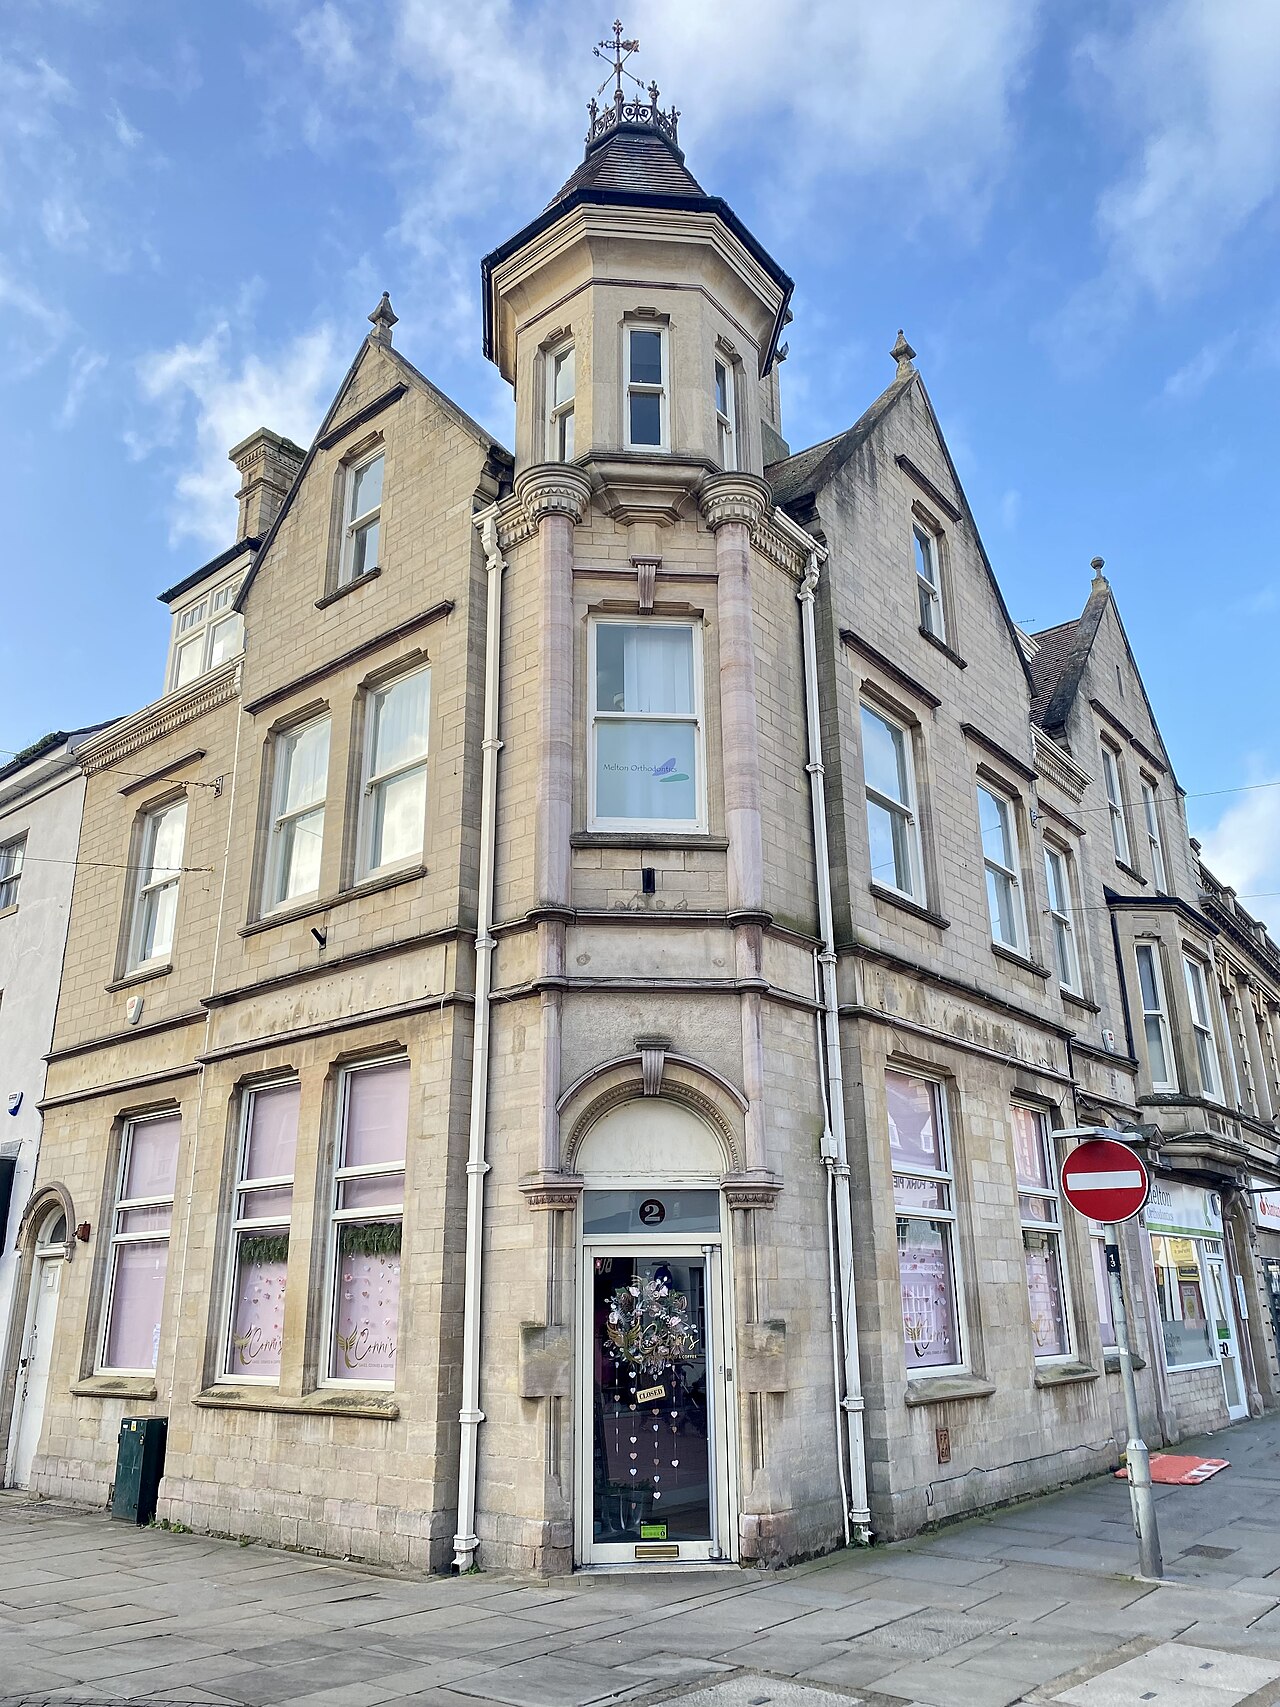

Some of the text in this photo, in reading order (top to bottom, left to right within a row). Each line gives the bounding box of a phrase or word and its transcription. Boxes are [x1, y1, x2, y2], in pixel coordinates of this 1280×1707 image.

[603, 763, 677, 773] Melton Orthodontics
[644, 1204, 661, 1222] 2
[639, 1388, 663, 1400] CLOSED
